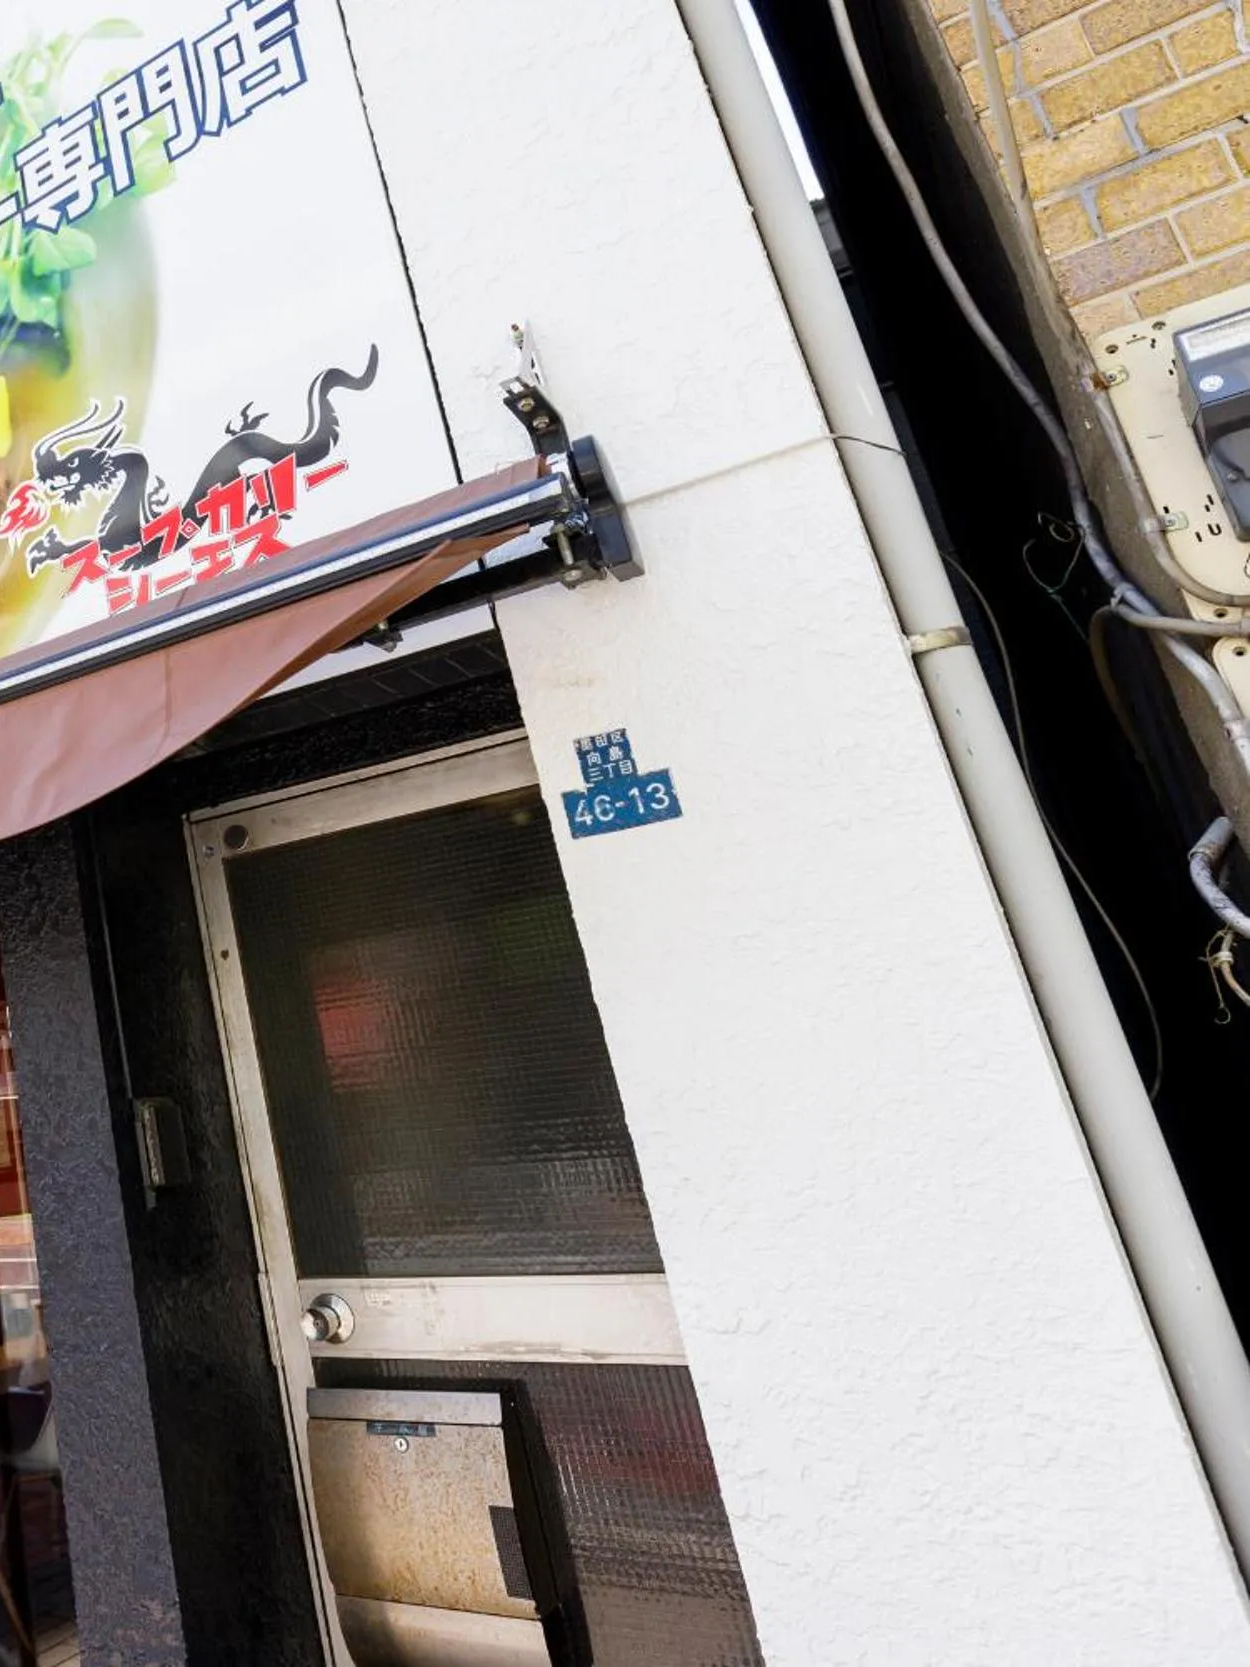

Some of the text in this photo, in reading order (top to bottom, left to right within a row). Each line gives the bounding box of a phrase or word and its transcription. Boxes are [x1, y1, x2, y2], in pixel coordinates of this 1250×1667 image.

[62, 452, 349, 594] スープカリー
[105, 515, 293, 614] シーエス
[575, 783, 670, 825] 46-13
[587, 760, 633, 782] 三丁目
